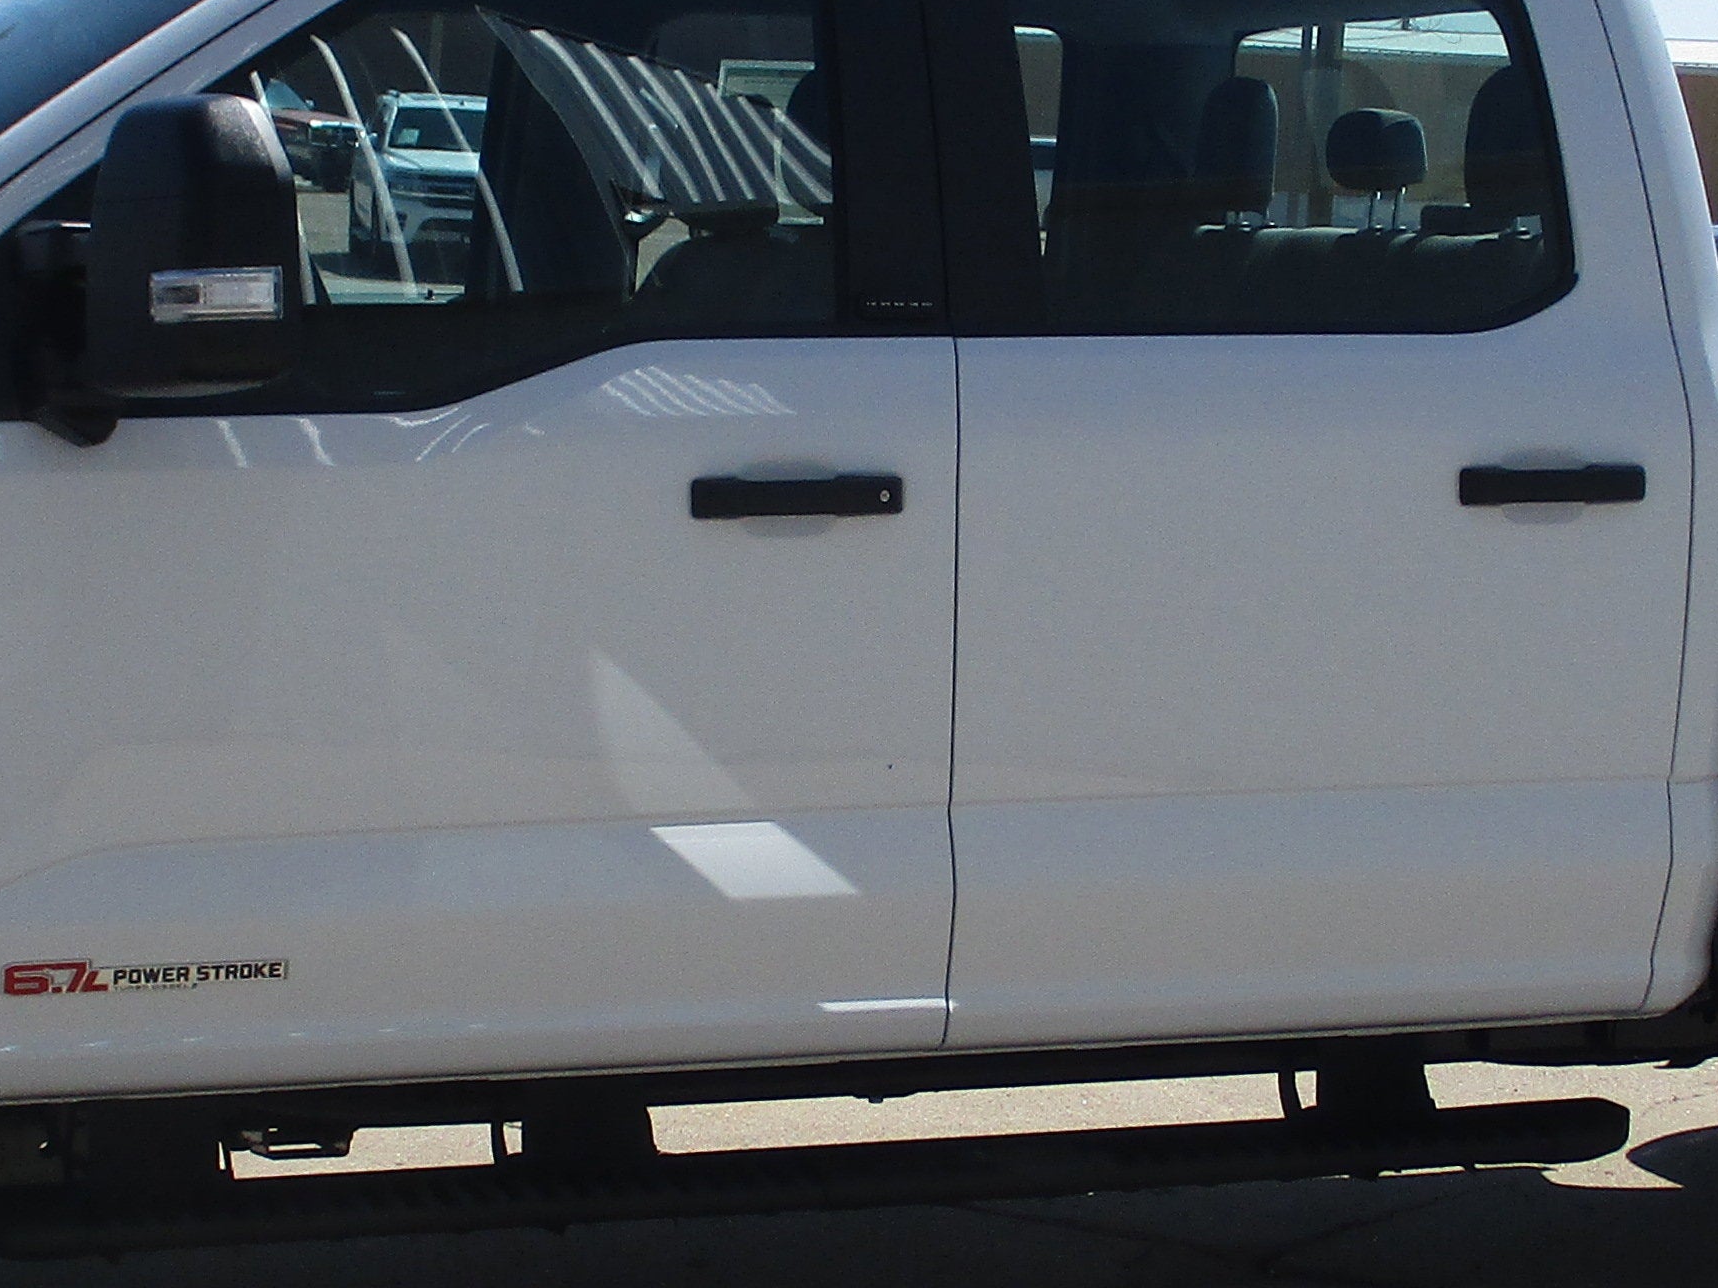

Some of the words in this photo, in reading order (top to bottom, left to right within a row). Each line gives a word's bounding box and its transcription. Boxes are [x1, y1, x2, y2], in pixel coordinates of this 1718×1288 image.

[2, 961, 109, 996] 6.7L
[112, 966, 190, 986] POWER
[195, 962, 283, 983] STROKE
